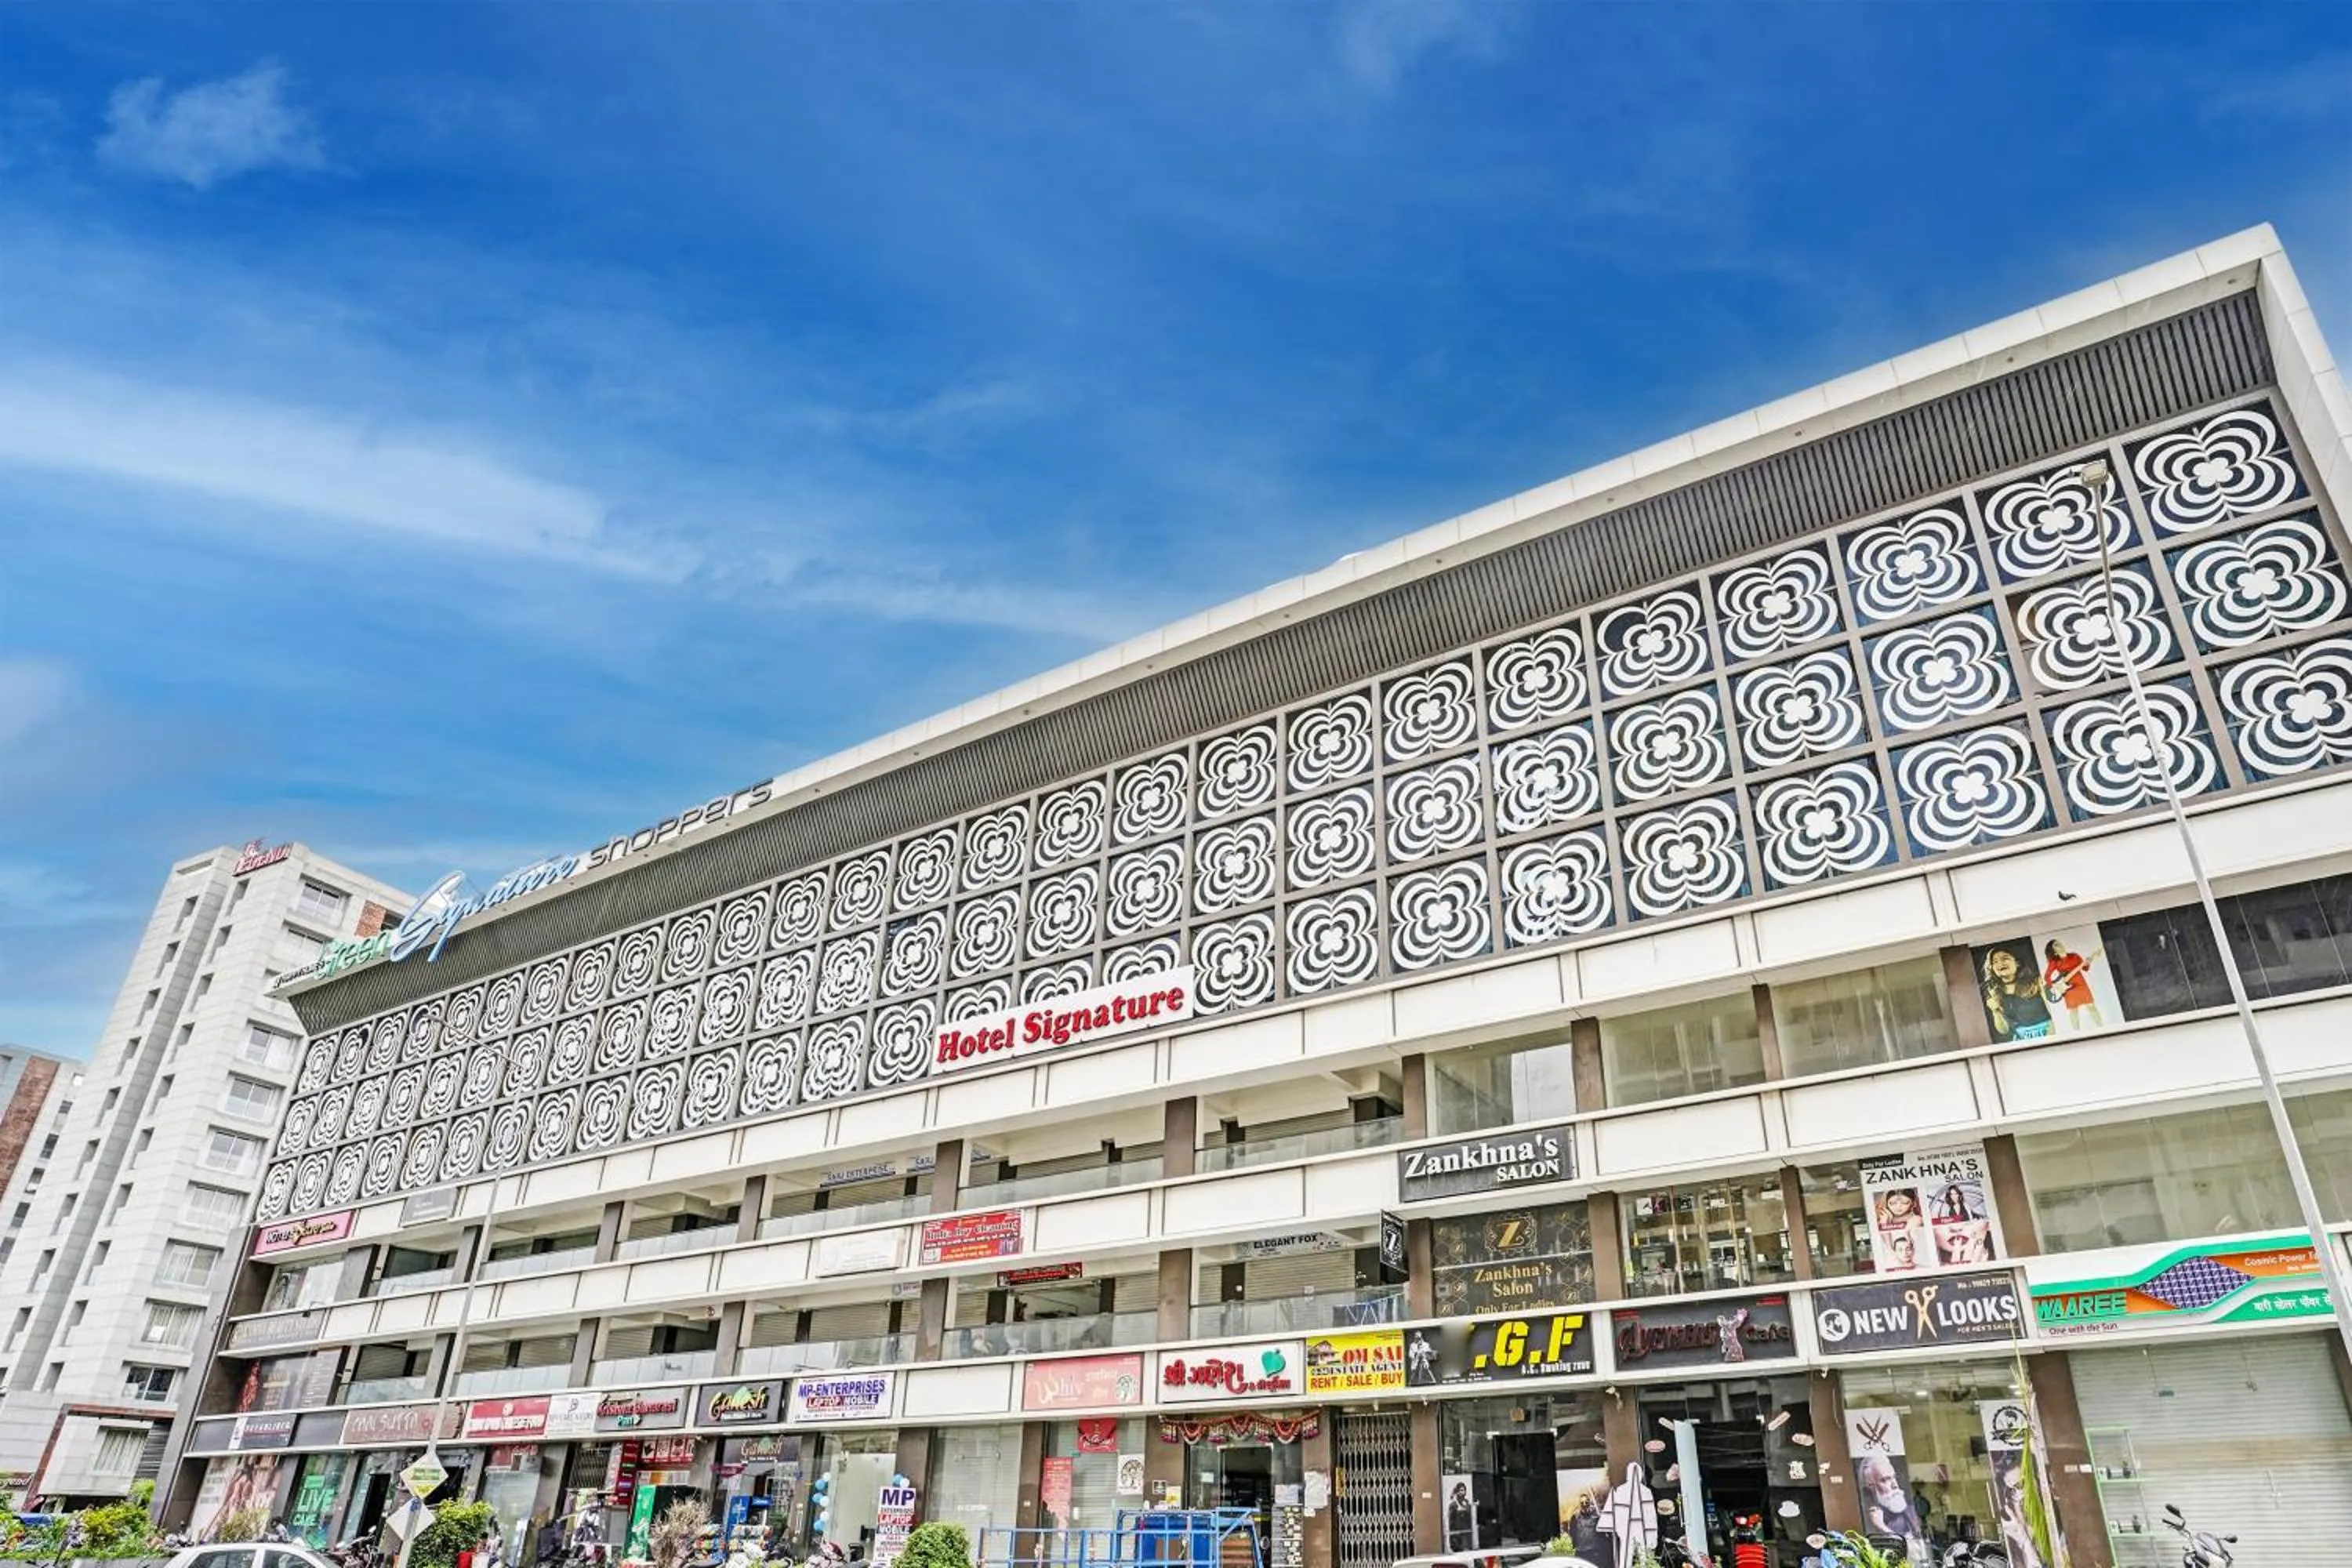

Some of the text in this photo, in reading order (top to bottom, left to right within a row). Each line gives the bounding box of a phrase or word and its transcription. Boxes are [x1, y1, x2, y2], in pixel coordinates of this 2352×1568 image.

[938, 987, 1184, 1062] Hotel Signature
[1405, 1134, 1559, 1178] Zankhna's
[1497, 1159, 1559, 1181] SALON
[1946, 1171, 1984, 1182] SALON
[1254, 1234, 1318, 1249] ELEGANT FOX
[1497, 1221, 1525, 1248] Z
[2245, 1256, 2278, 1266] Cosmic
[2278, 1254, 2305, 1264] Power
[1474, 1261, 1552, 1283] Zankhna's
[1493, 1282, 1534, 1298] Salon
[1853, 1295, 2017, 1335] NEW LOOKS
[2035, 1292, 2126, 1322] WAAREE
[1342, 1346, 1403, 1363] OM SAI
[798, 1380, 885, 1397] MP-ENTERPRISES
[1311, 1376, 1338, 1389] RENT
[1346, 1374, 1373, 1386] SALE
[1381, 1373, 1403, 1385] BUY
[297, 1489, 335, 1512] LIVE
[882, 1489, 915, 1506] MP
